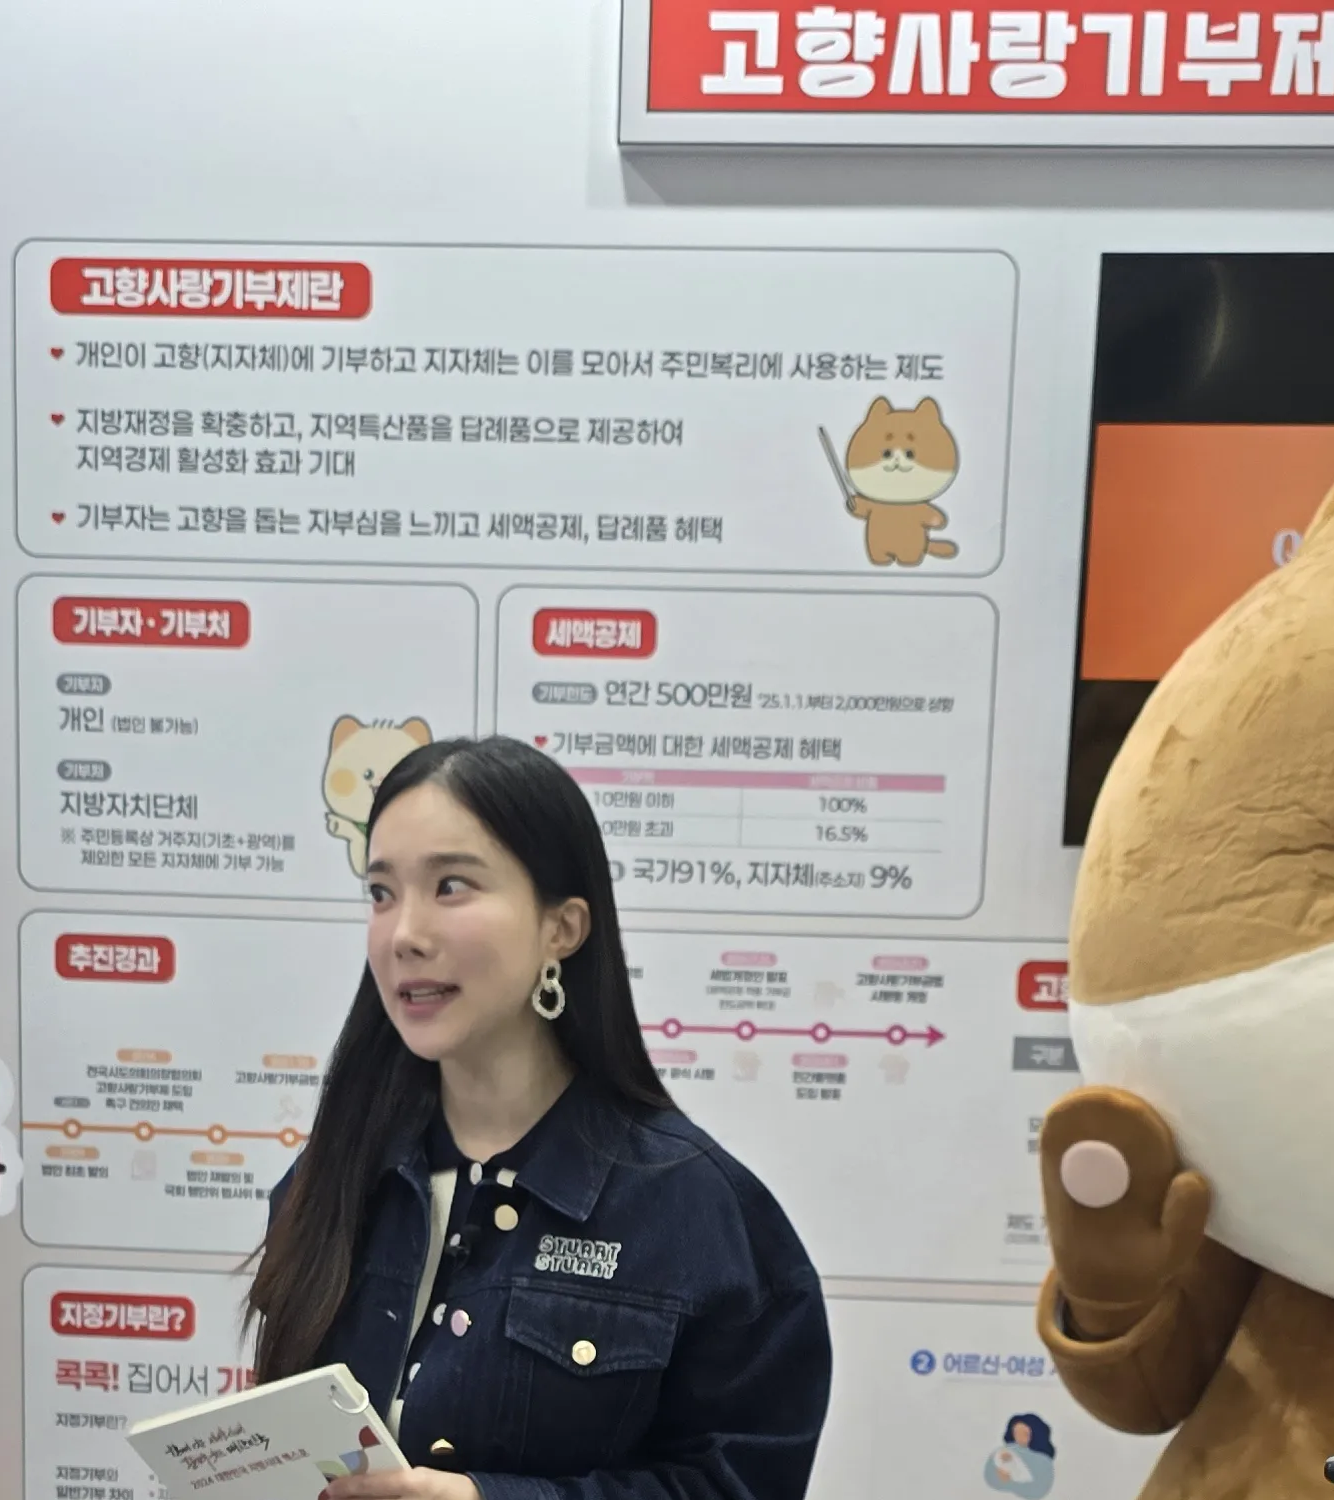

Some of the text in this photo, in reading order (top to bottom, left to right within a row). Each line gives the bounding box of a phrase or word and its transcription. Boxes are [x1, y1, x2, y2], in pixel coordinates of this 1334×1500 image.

[80, 267, 345, 312] 고향사랑기부제란
[75, 341, 945, 381] 개인이 고향(지자체)에 기부하고 지자체는 이를 모아서 주민복리에 사용하는 제도
[76, 408, 684, 446] 지방재정을 확충하고, 지역특산품을 답례품으로 제공하여
[76, 445, 356, 477] 지역경제 활성화 효과 기대
[76, 503, 723, 544] 기부자는 고향을 돕는 자부심을 느끼고 세액공제, 답례품 혜택
[547, 617, 643, 650] 세액공제
[605, 680, 651, 707] 연간
[657, 682, 753, 710] 500만원
[58, 706, 105, 733] 개인
[111, 716, 146, 735] (법인
[551, 731, 842, 761] 기부금액에 대한 세액공제 혜택
[59, 791, 198, 820] 지방자치단체
[594, 791, 675, 809] 10만원 이하
[819, 797, 867, 813] 100%
[601, 820, 674, 838] 0만원 초과
[816, 825, 868, 843] 16.5%
[80, 850, 285, 873] 제외한 모든 지자체에 기부 가능
[633, 858, 742, 889] 국가91%,
[869, 864, 913, 890] 9%
[69, 943, 161, 974] 추진경과
[59, 1301, 187, 1332] 지정기부란?
[55, 1358, 120, 1392] 콕콕!
[127, 1362, 209, 1396] 집어서
[55, 1412, 128, 1430] 지정기부란?
